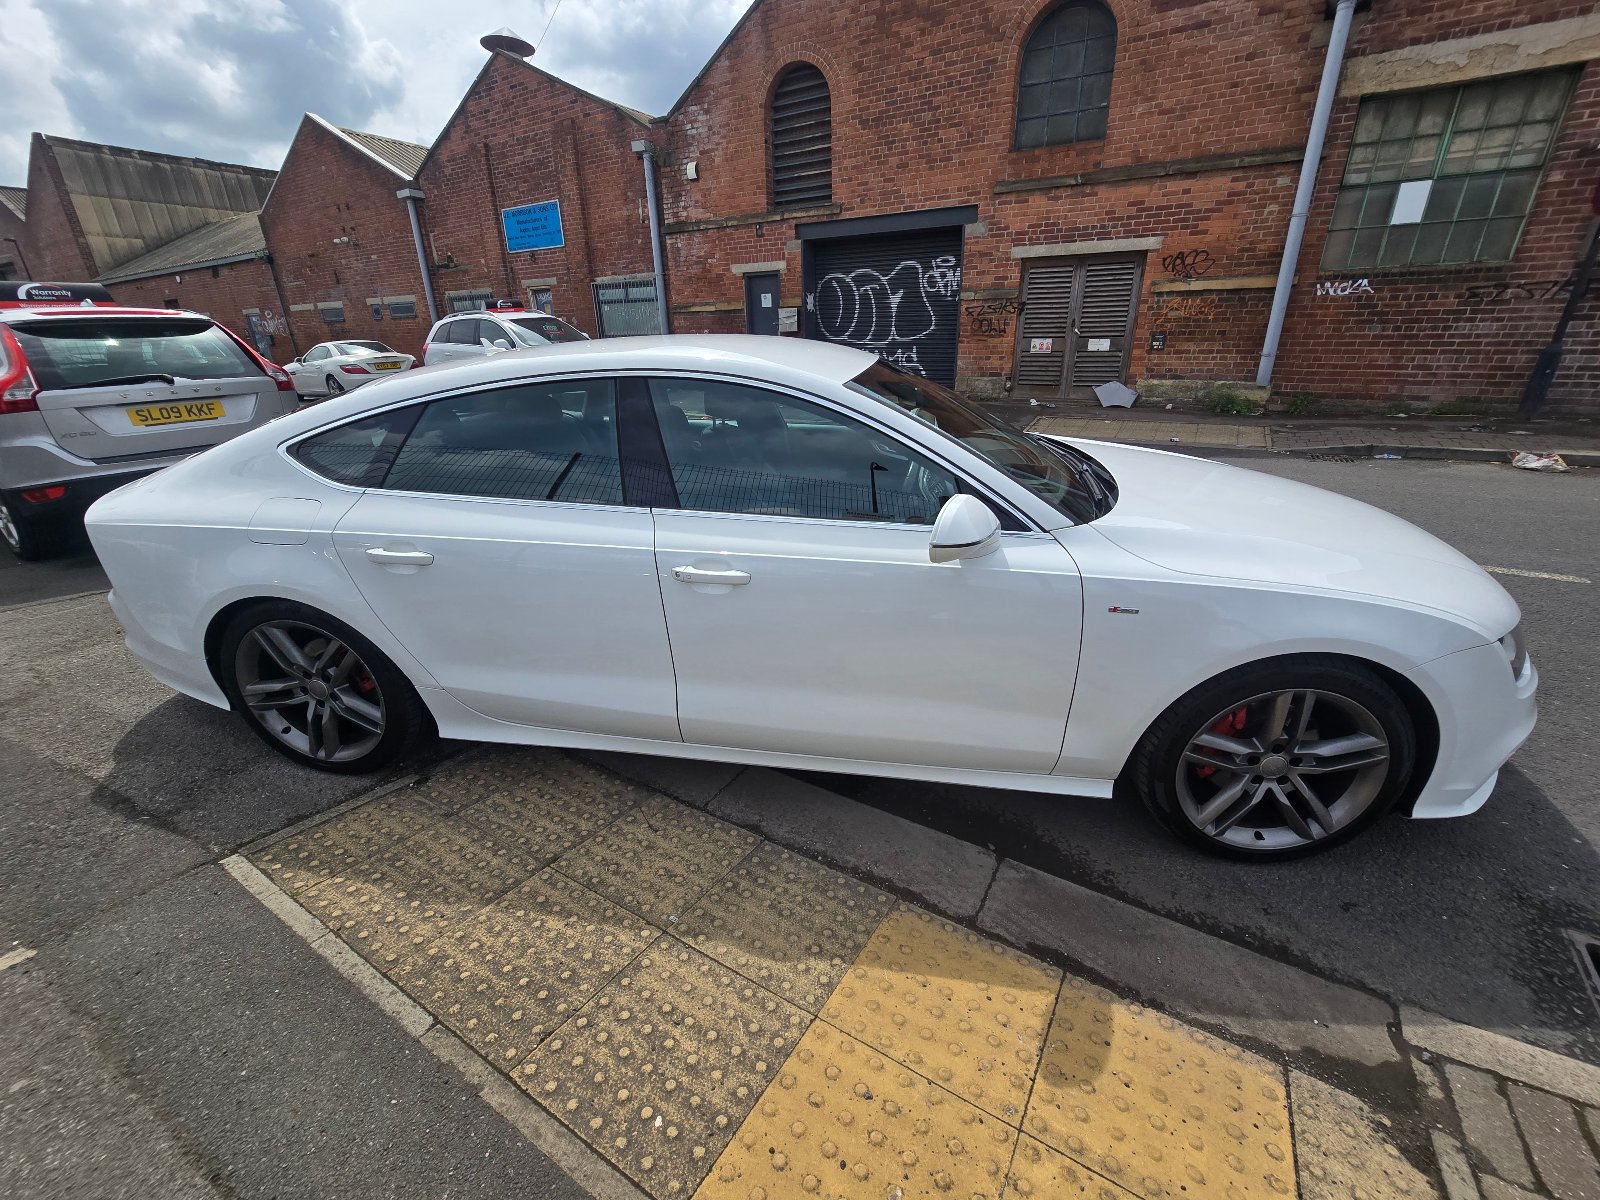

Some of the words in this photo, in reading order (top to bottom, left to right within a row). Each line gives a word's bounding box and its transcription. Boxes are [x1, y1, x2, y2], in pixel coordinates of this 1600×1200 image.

[29, 289, 71, 297] Warranty
[120, 387, 221, 398] VOLVO
[135, 406, 183, 422] SL09
[184, 403, 216, 418] KKF
